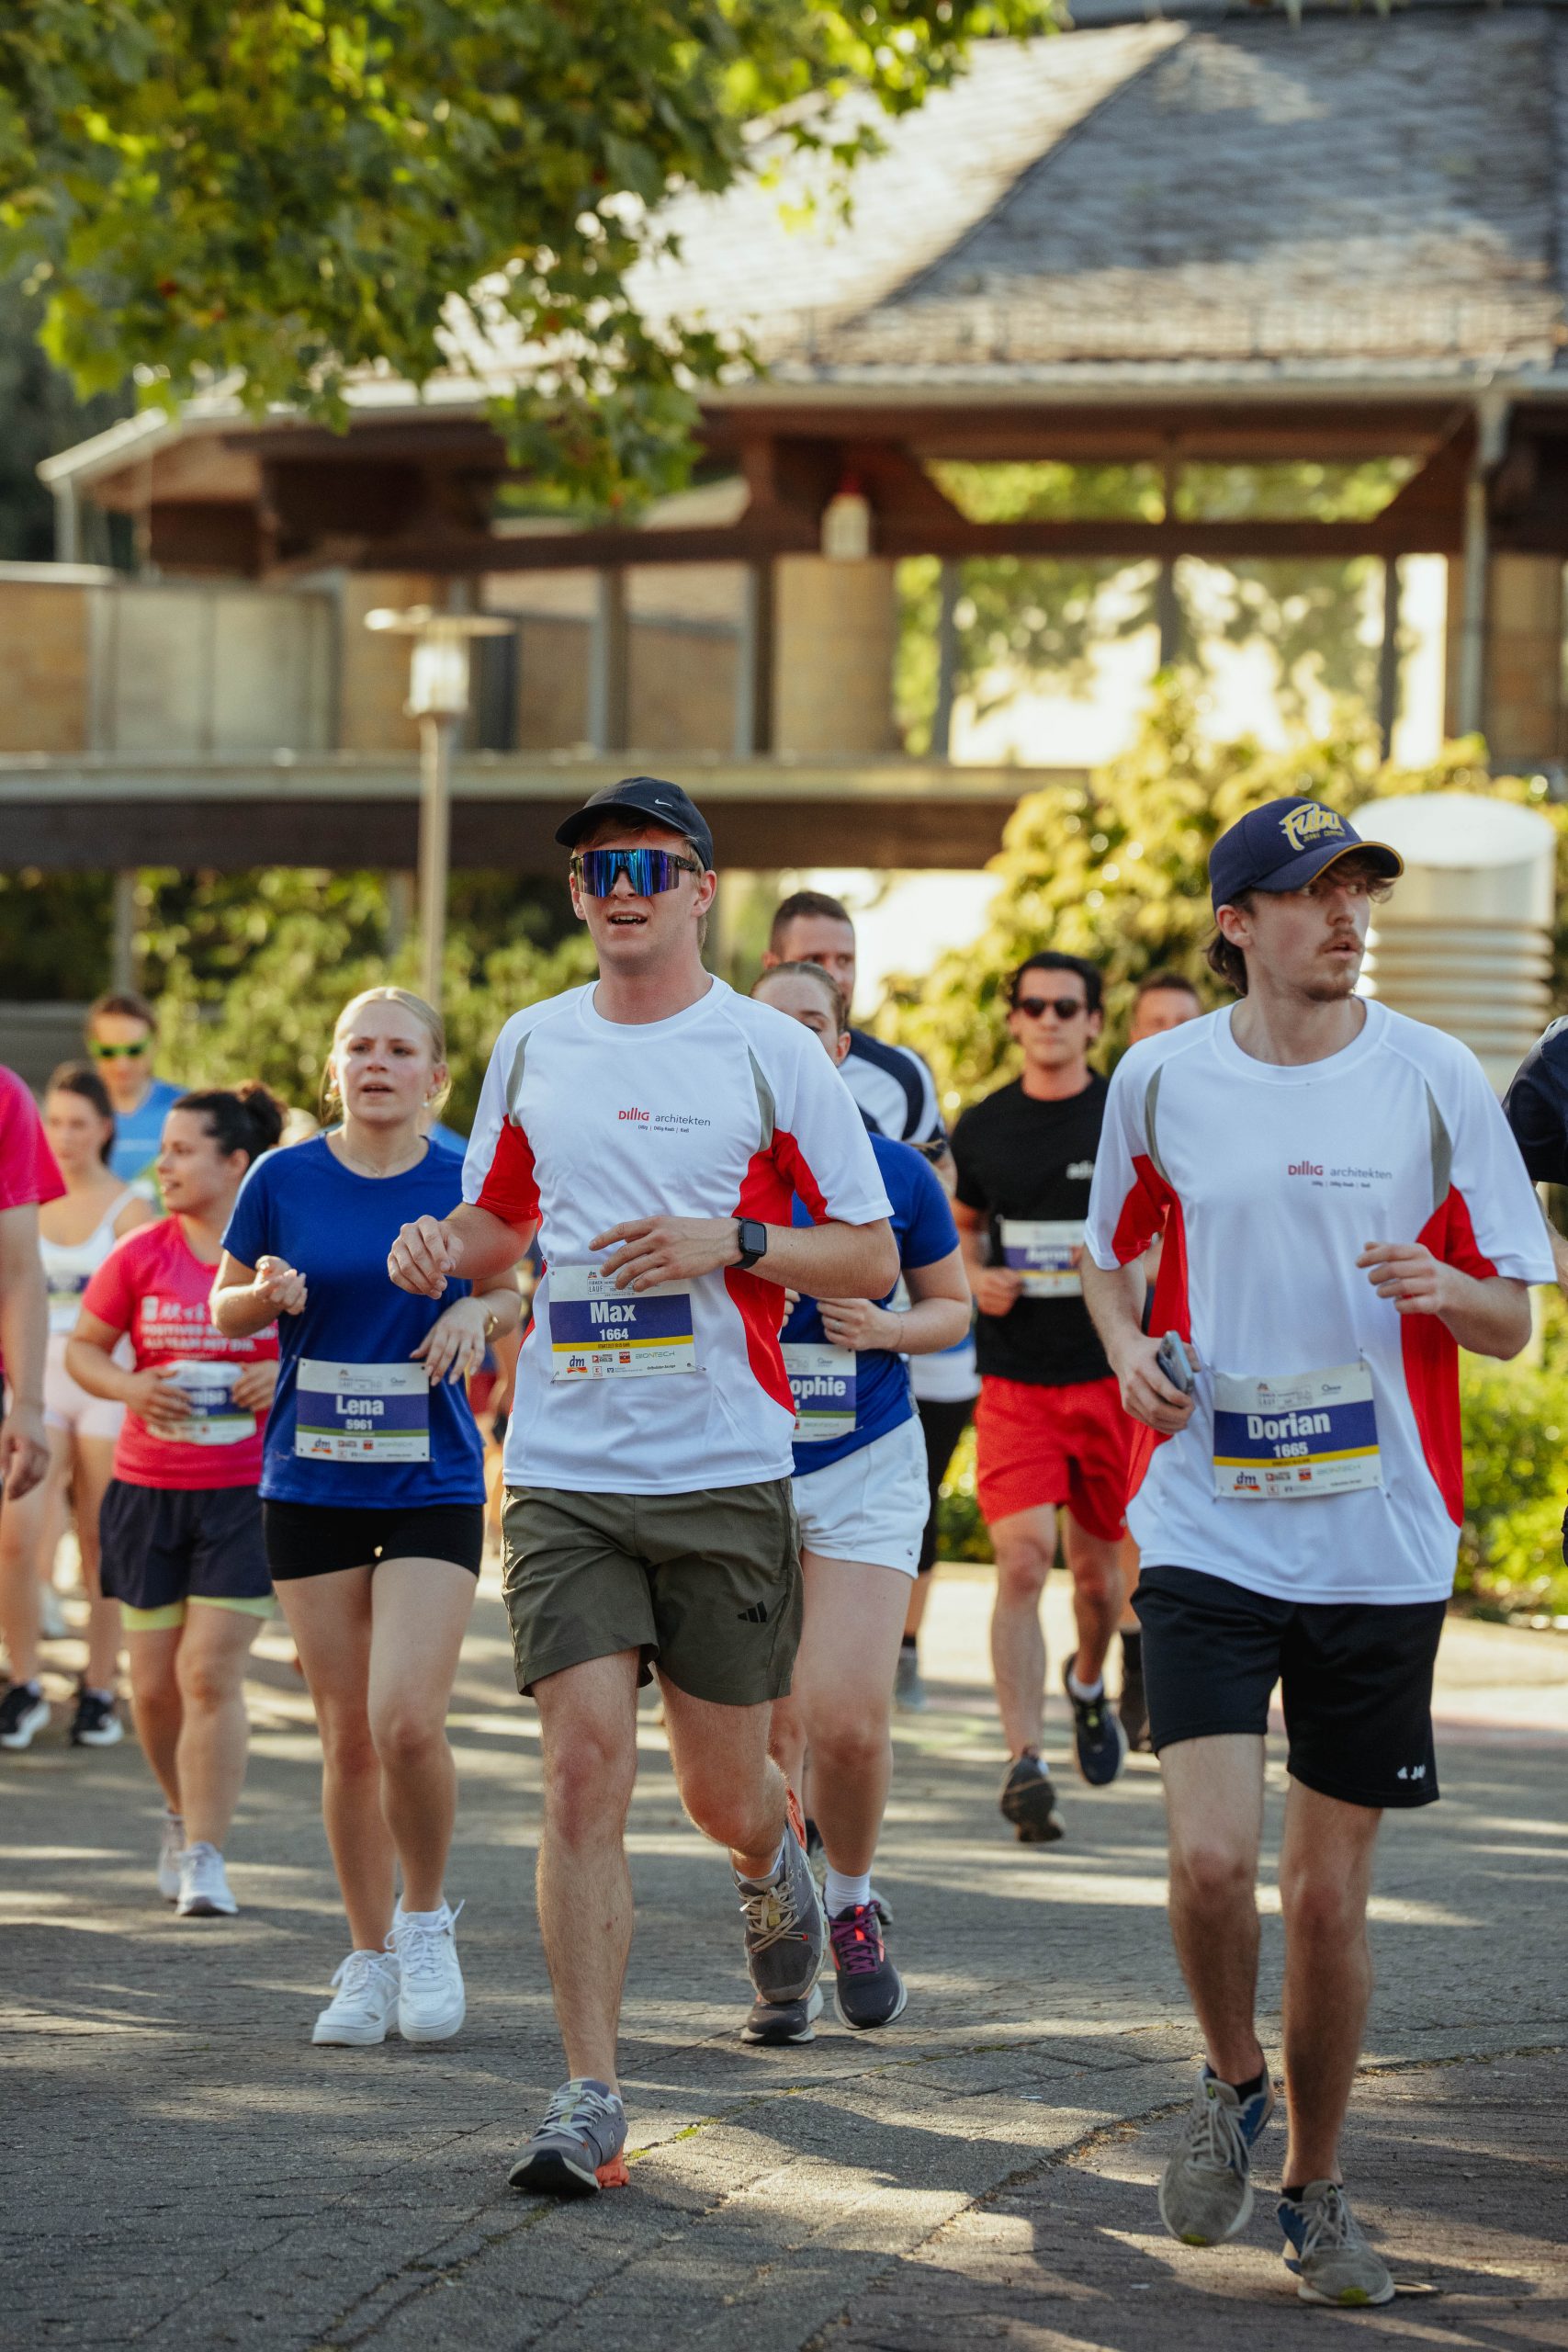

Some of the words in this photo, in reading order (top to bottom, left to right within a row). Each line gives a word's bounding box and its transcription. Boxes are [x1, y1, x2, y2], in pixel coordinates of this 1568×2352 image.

[655, 1114, 711, 1126] architekten
[1330, 1167, 1393, 1180] architekten
[590, 1301, 637, 1324] Max
[600, 1328, 629, 1341] 1664
[570, 1355, 584, 1367] dm
[788, 1376, 846, 1399] ophie
[336, 1395, 384, 1416] Lena
[345, 1419, 373, 1430] 5961
[1247, 1412, 1331, 1440] Dorian
[315, 1438, 331, 1448] dm
[1273, 1442, 1308, 1458] 1665
[1236, 1472, 1257, 1485] dm
